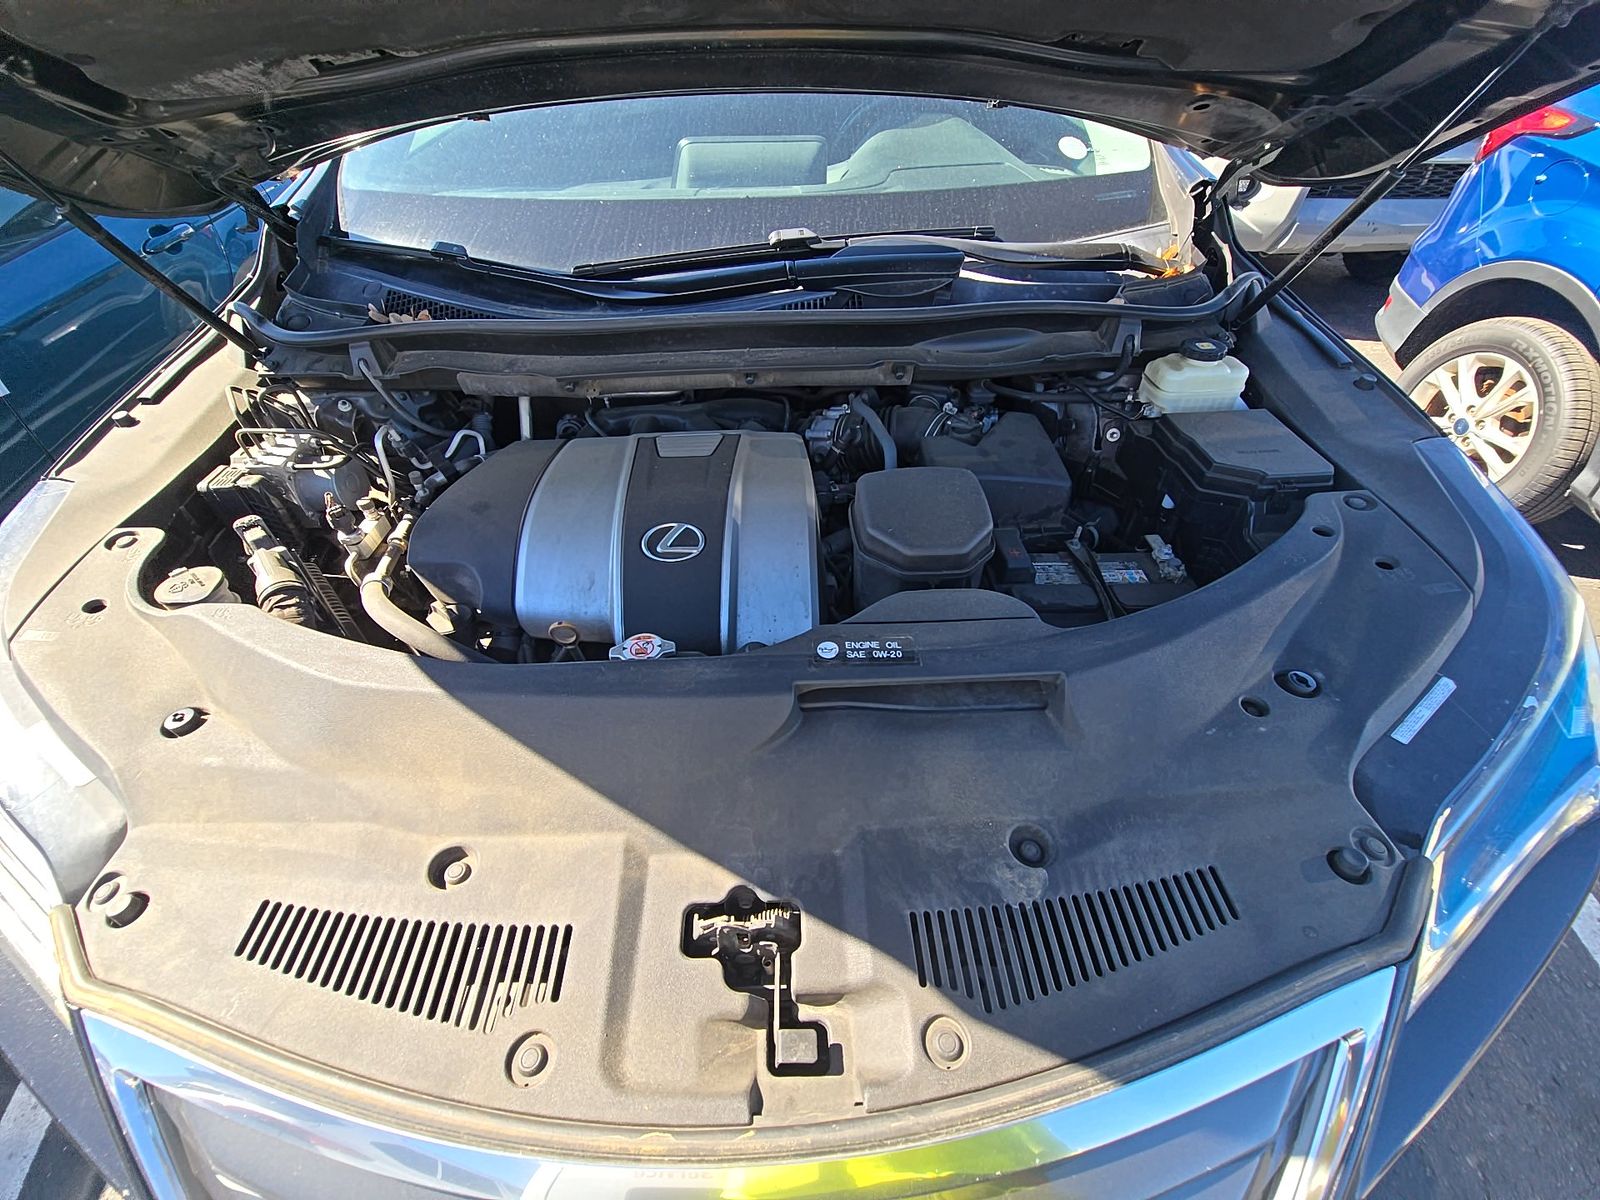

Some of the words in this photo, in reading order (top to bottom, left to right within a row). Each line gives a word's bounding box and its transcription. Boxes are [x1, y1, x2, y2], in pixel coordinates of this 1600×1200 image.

[845, 641, 880, 649] ENGINE
[885, 641, 902, 649] OIL
[846, 650, 866, 658] SAE
[872, 650, 903, 658] 0W-20
